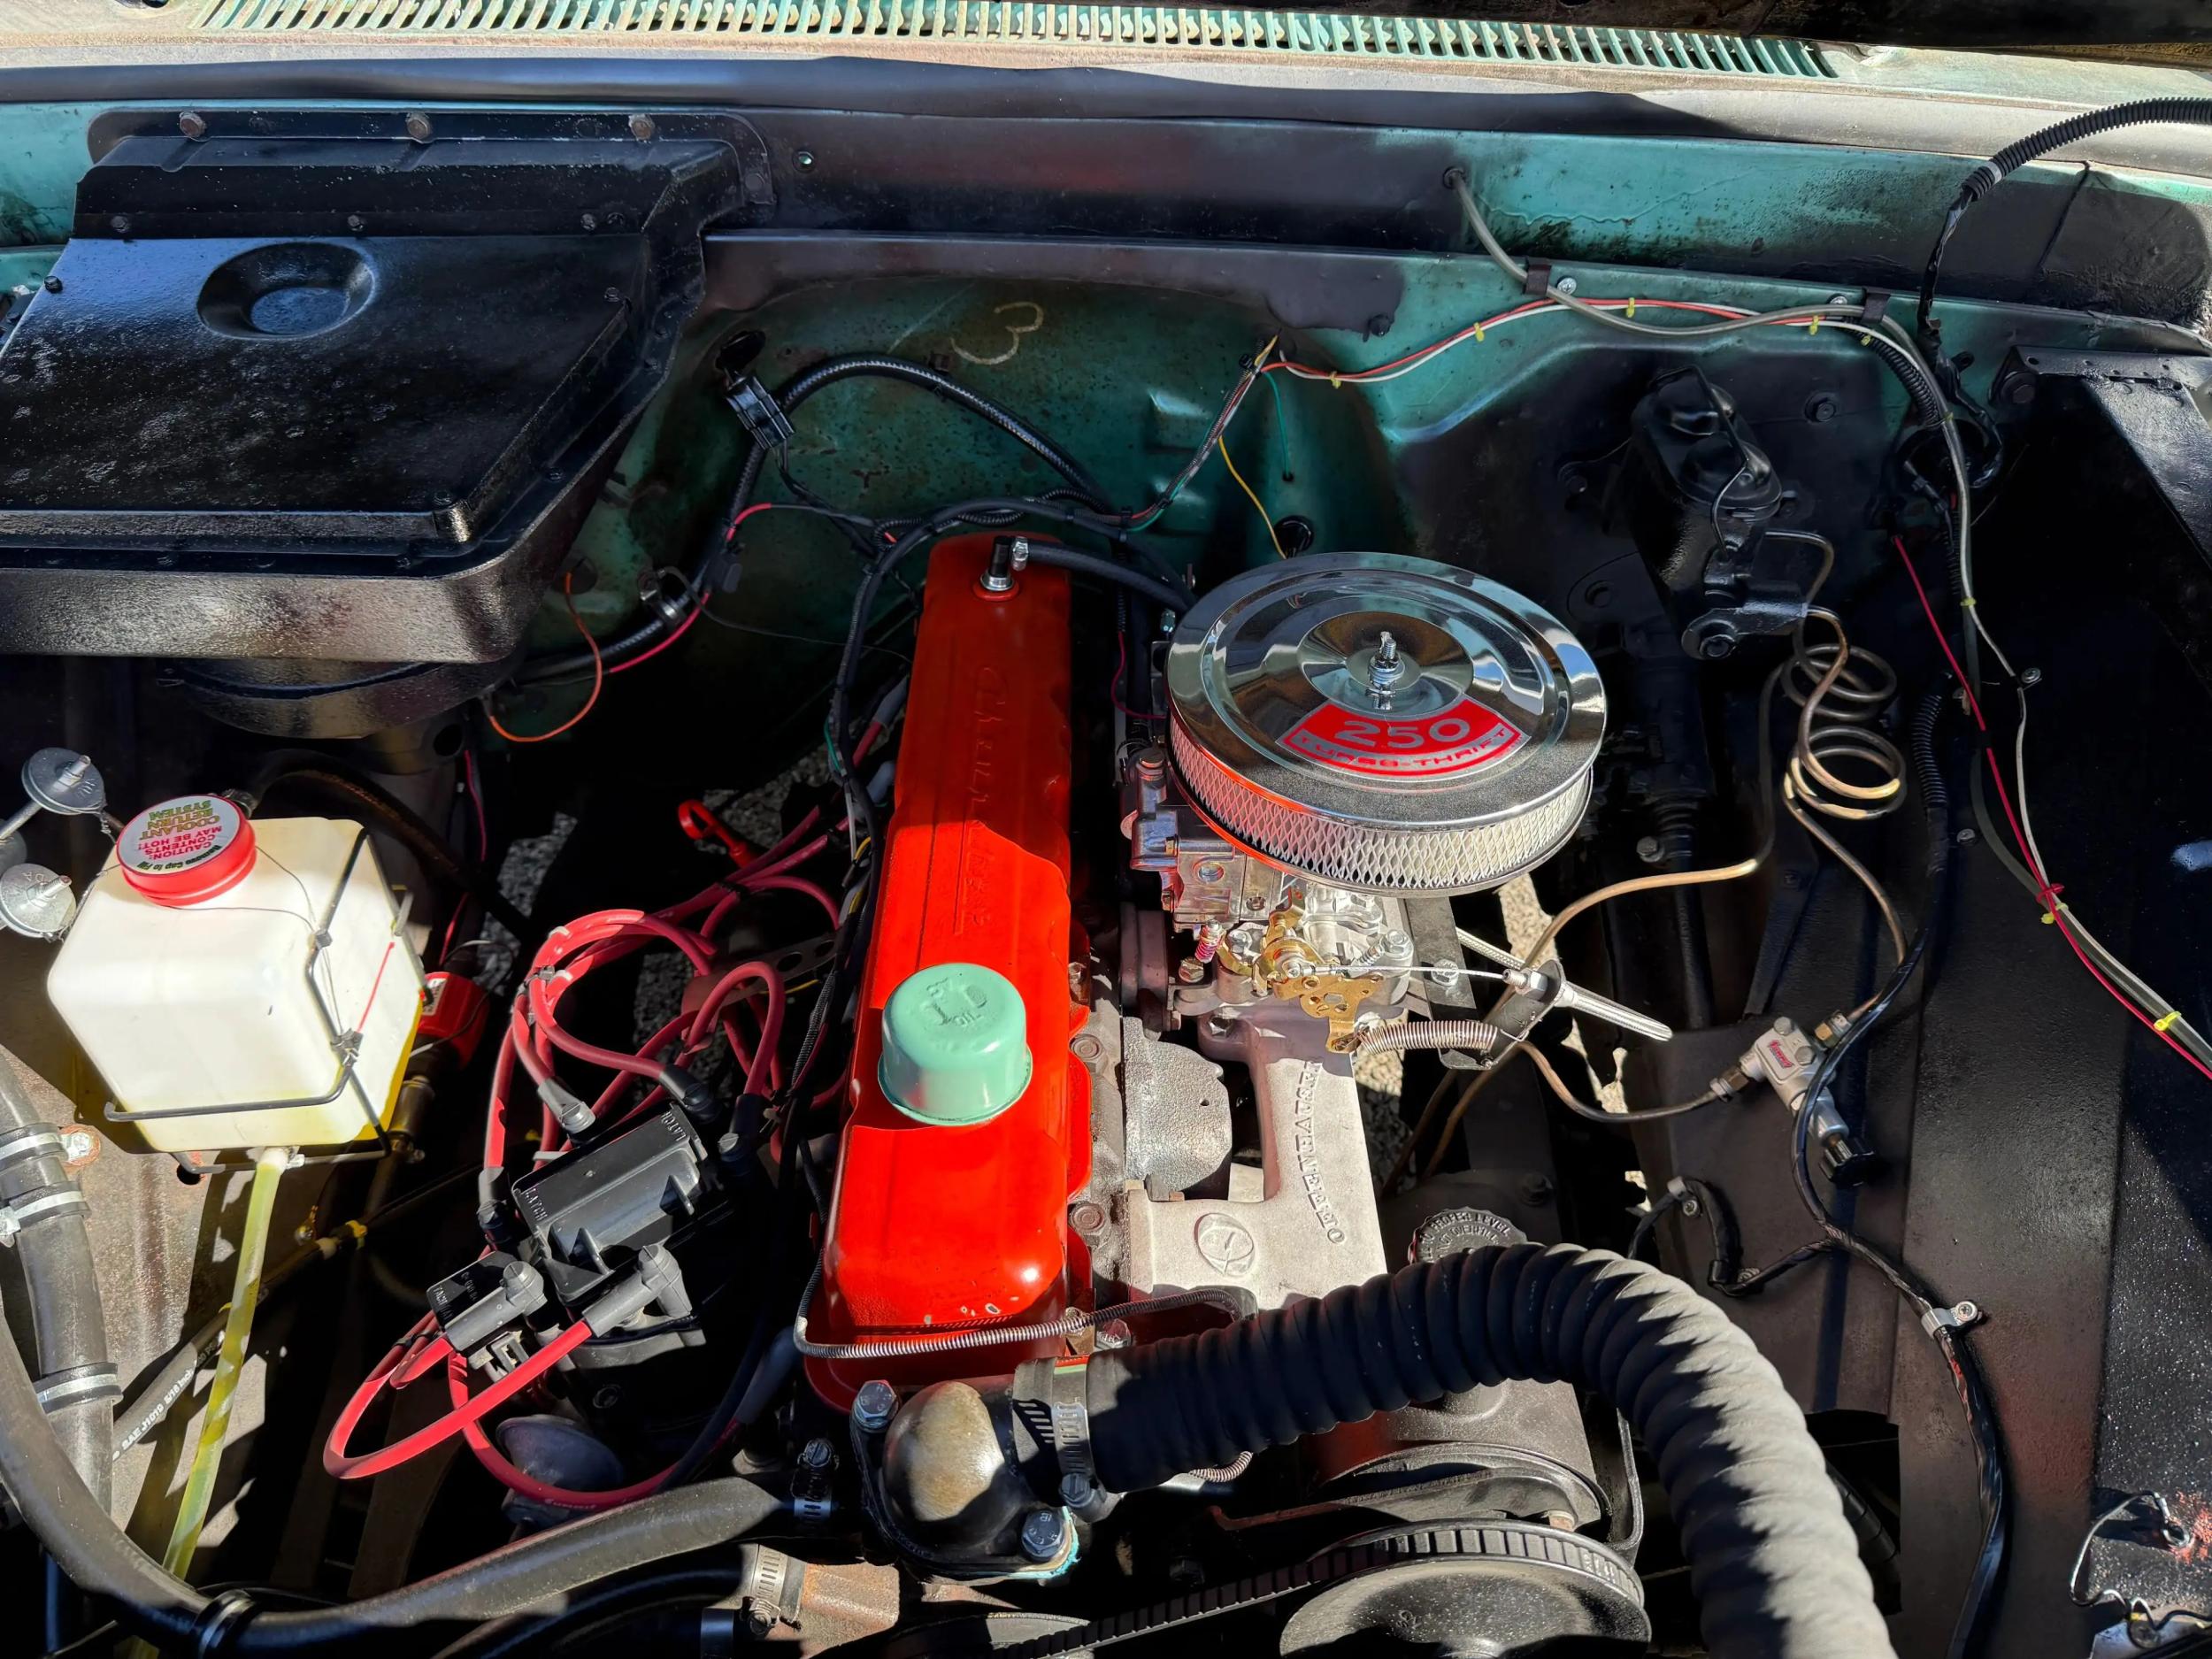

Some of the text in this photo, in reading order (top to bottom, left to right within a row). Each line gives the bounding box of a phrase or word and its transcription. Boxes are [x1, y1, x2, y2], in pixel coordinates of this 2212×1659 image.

[950, 302, 1044, 365] 3
[1333, 718, 1471, 749] 250
[1299, 728, 1507, 767] TURBO-THRIFT
[147, 808, 213, 830] RETURN
[148, 800, 211, 821] SYSTEM
[138, 826, 223, 851] MAY BE HOT!
[139, 815, 220, 841] COOLANT
[136, 844, 222, 872] Remove Cap to Fill
[145, 834, 216, 856] CONTENTS
[150, 841, 211, 860] CAUTION:
[525, 1187, 549, 1221] LATCH
[1430, 1211, 1473, 1233] PROPER
[1475, 1212, 1512, 1237] LEVEL
[121, 1426, 142, 1450] SAE
